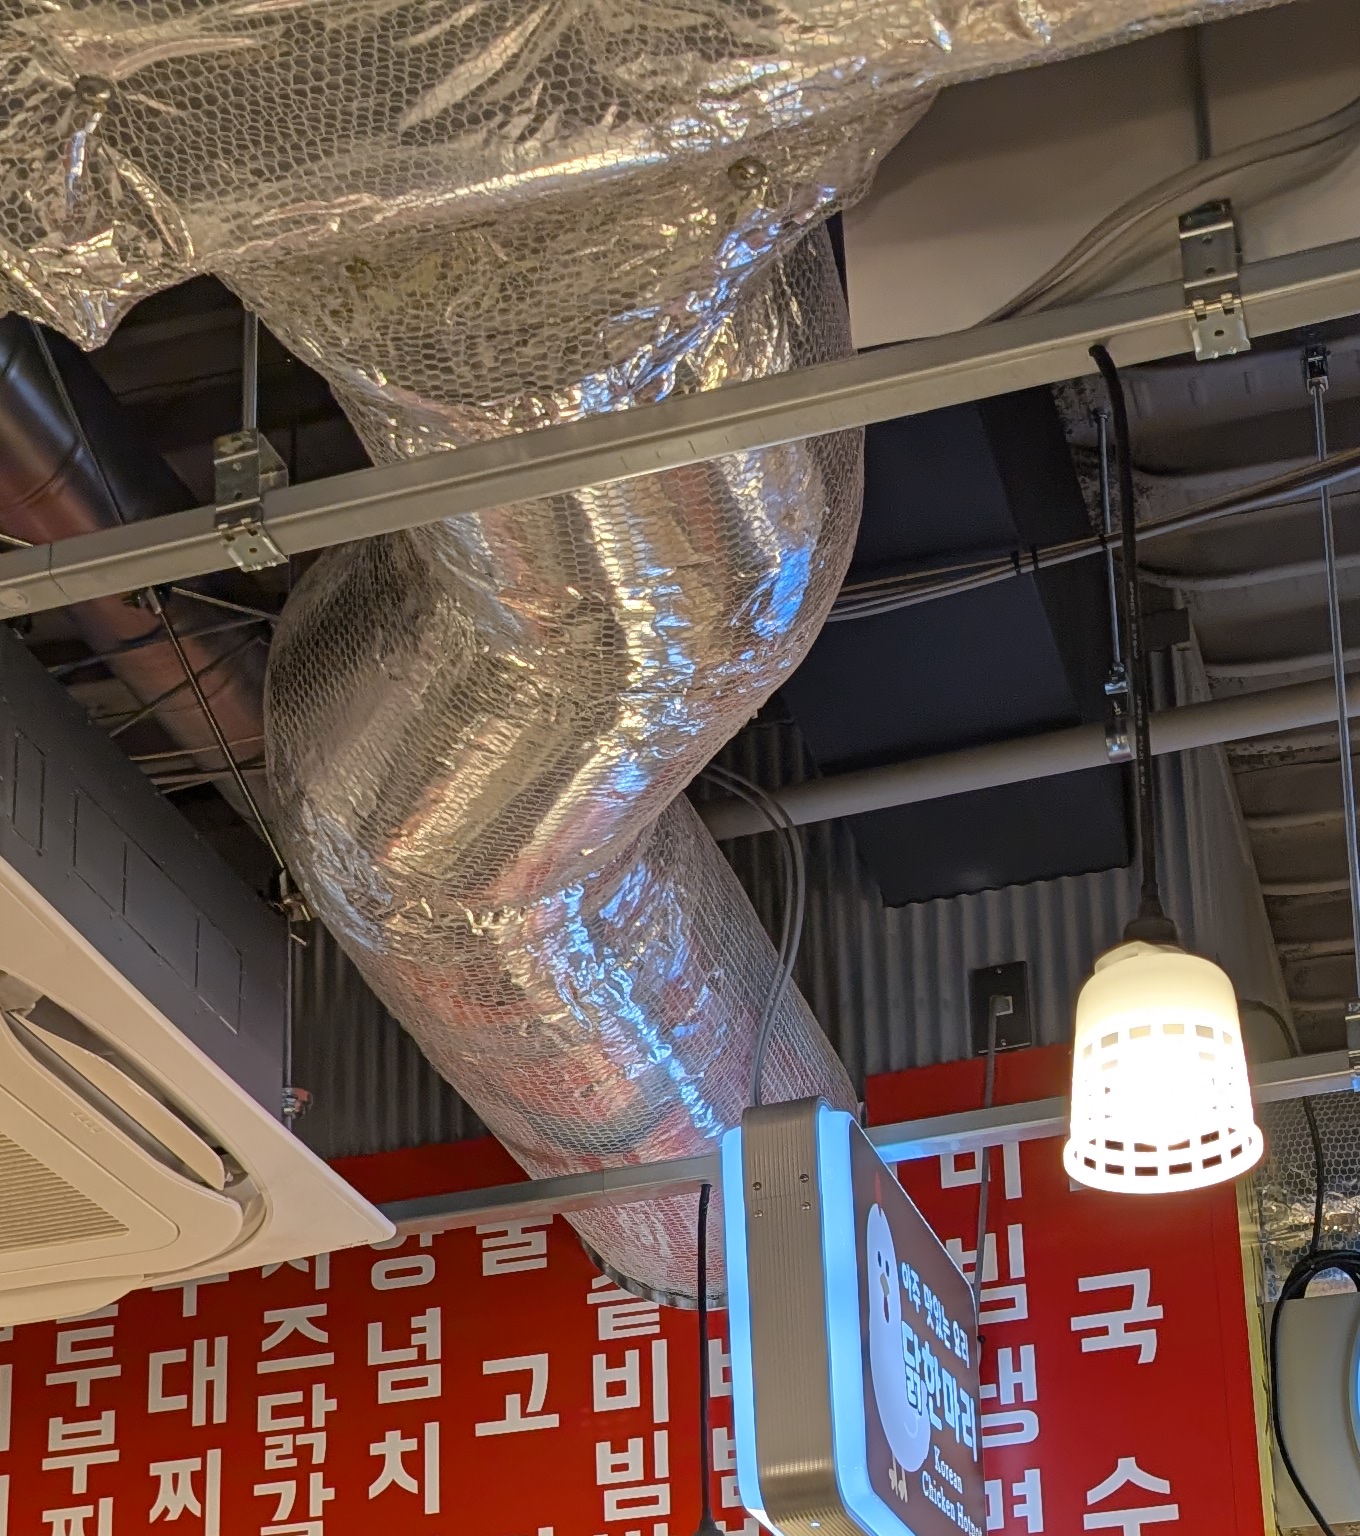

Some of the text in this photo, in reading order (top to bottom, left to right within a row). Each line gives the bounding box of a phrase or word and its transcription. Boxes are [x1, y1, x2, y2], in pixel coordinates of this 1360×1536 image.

[902, 1261, 921, 1314] 아주
[953, 1320, 970, 1369] 요리
[901, 1320, 978, 1463] 닭한마리
[921, 1469, 956, 1520] Chicken
[934, 1445, 963, 1495] Korean
